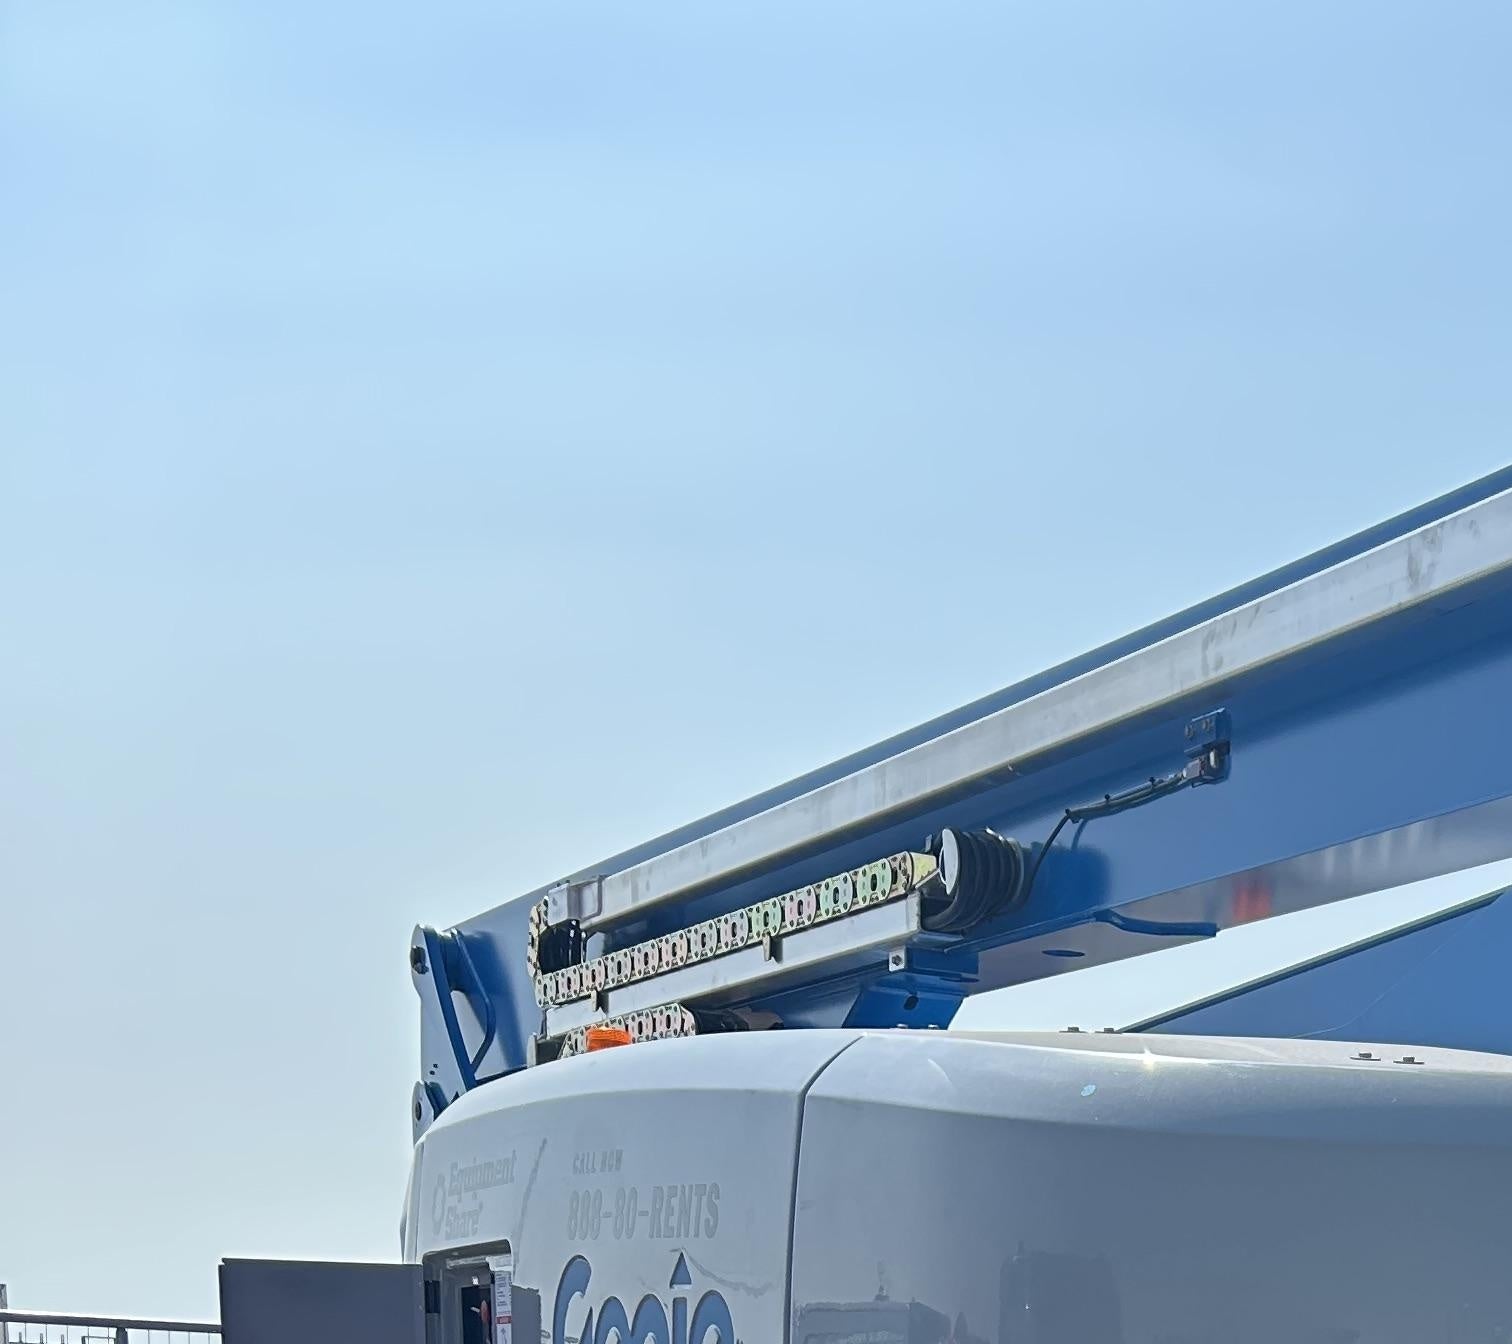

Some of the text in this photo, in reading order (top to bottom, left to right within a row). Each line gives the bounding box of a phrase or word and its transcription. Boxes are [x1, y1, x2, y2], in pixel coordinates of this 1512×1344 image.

[448, 1149, 516, 1203] Equipment
[573, 1149, 623, 1175] CALL NOW
[568, 1182, 721, 1240] 888-80-RENTS
